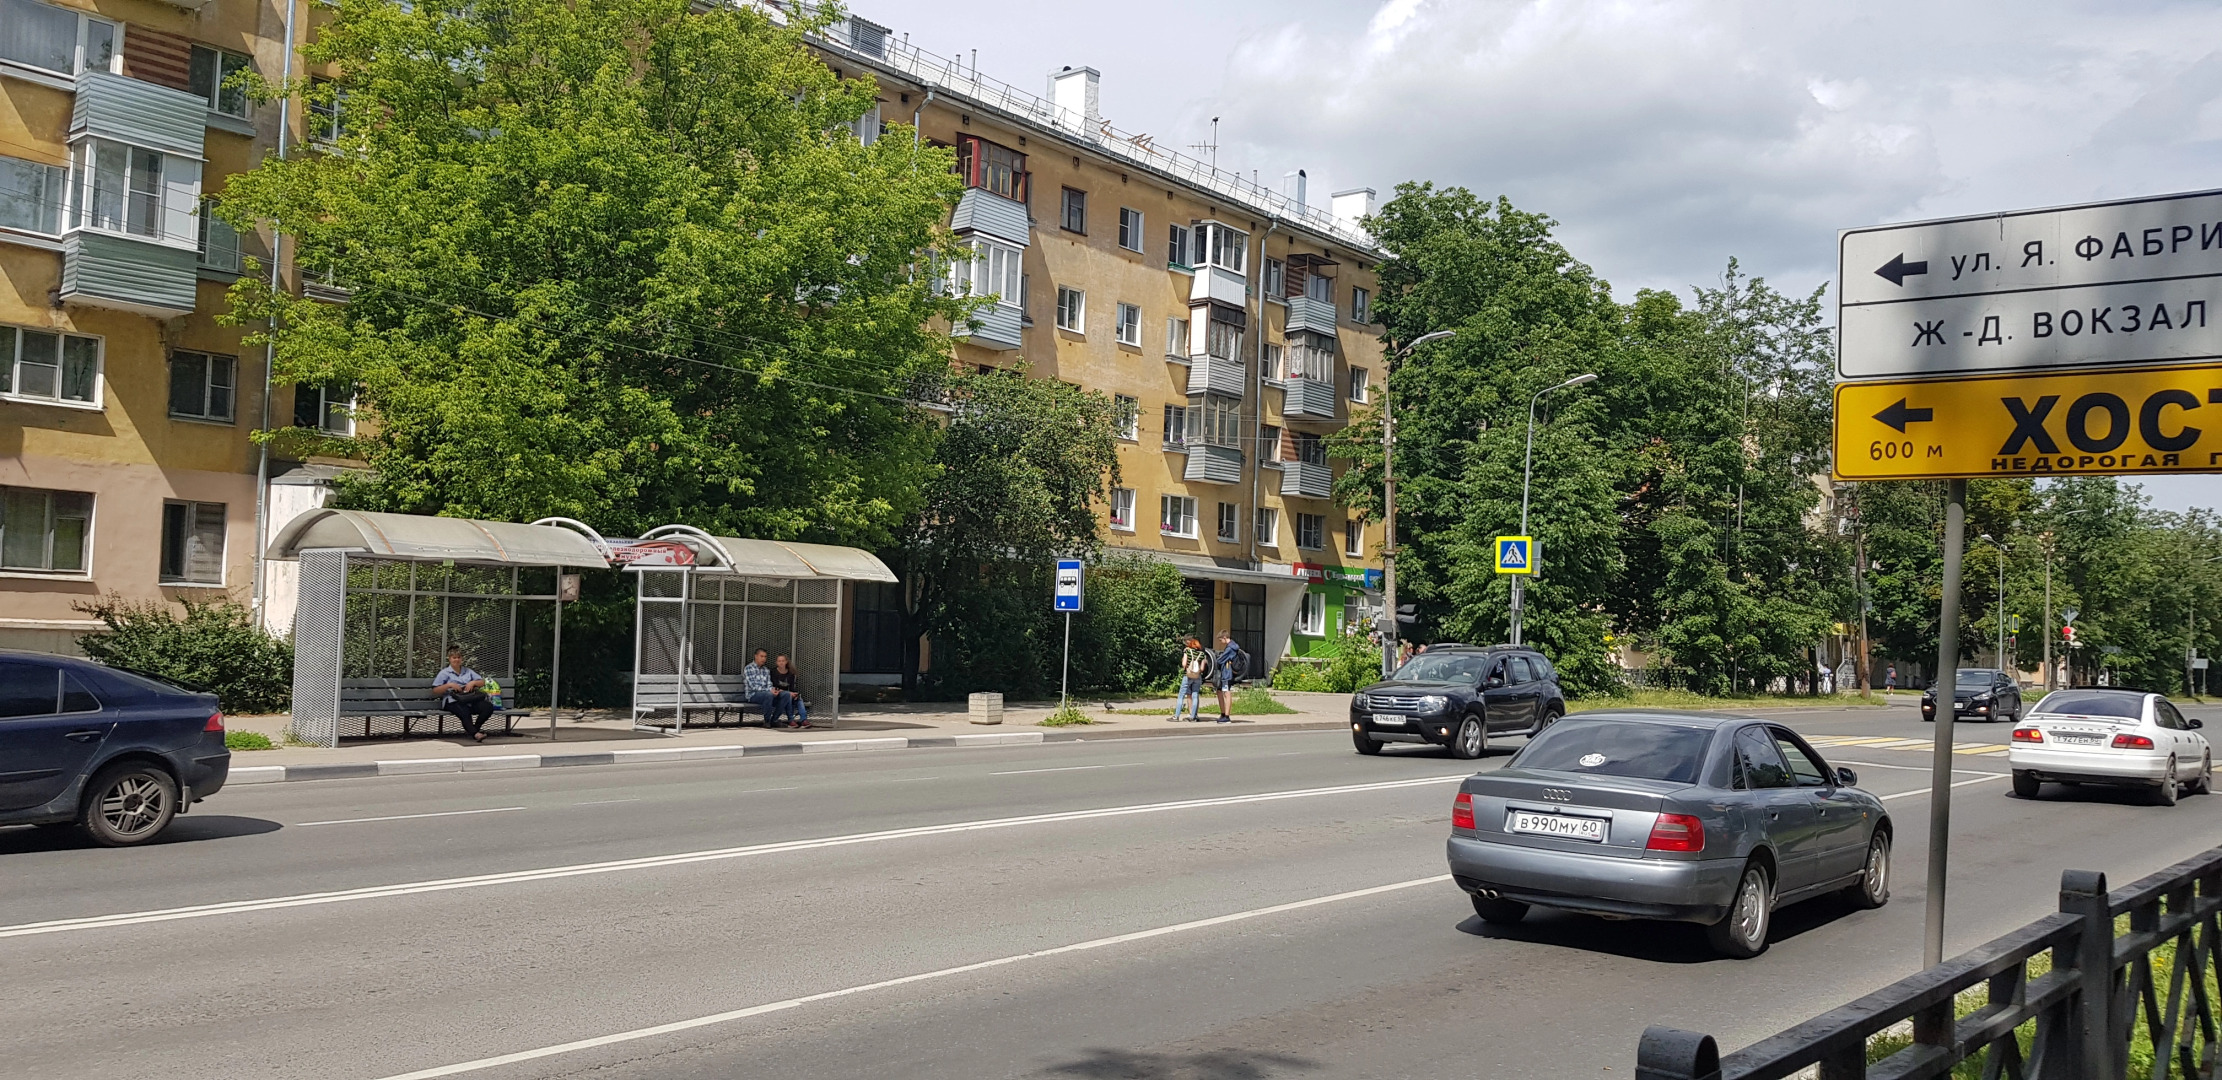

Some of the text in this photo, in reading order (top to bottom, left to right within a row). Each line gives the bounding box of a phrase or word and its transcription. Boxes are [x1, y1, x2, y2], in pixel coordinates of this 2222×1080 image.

[1951, 222, 2222, 281] ул. Я. ФАБРИ
[2033, 299, 2206, 338] ВОКЗАЛ
[1869, 441, 1914, 461] 600
[1991, 453, 2180, 472] НЕДОРОГАЯ
[1581, 821, 1597, 832] 60
